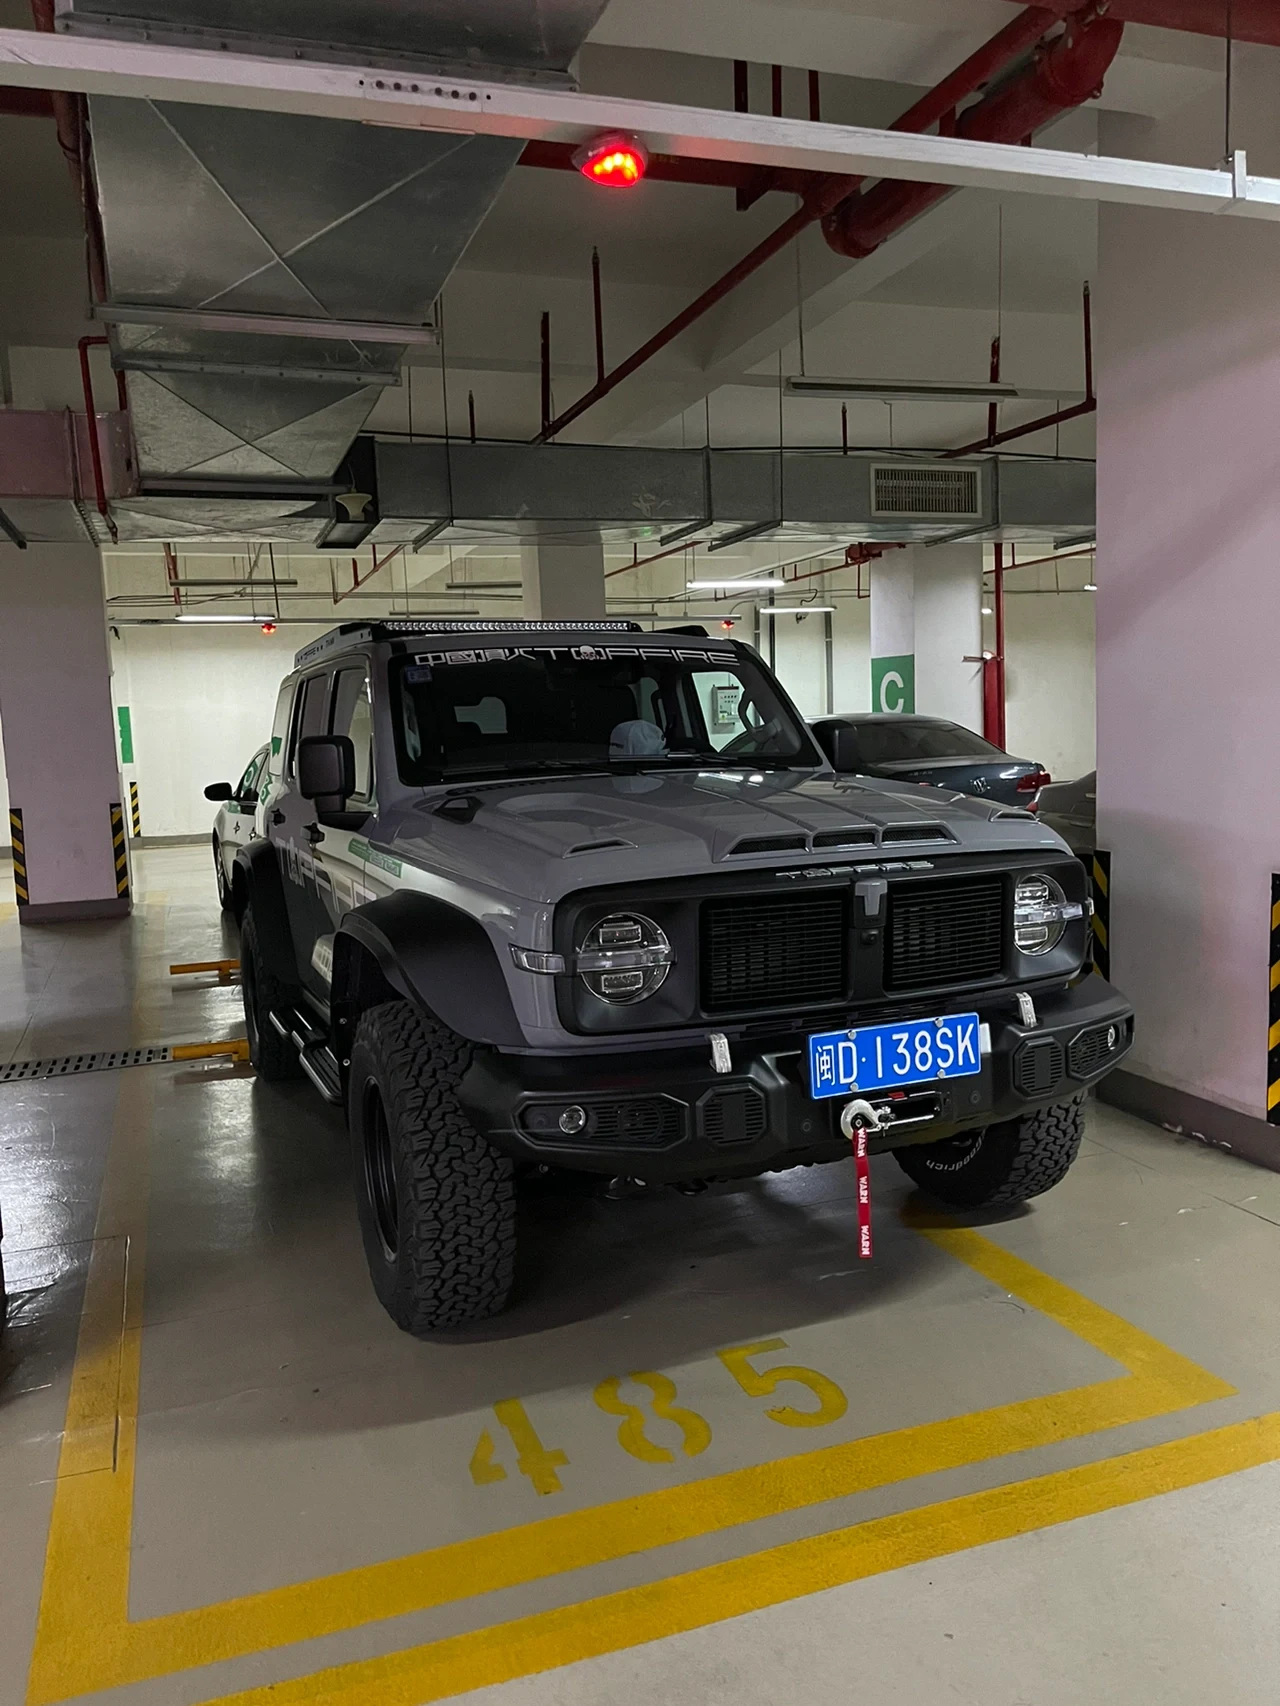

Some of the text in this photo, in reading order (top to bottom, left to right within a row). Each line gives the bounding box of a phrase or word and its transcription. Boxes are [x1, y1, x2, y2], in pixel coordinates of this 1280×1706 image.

[880, 670, 904, 714] C
[857, 1127, 866, 1158] WARN
[859, 1175, 868, 1204] WARN
[861, 1224, 870, 1256] WARN
[468, 1337, 849, 1497] 485
